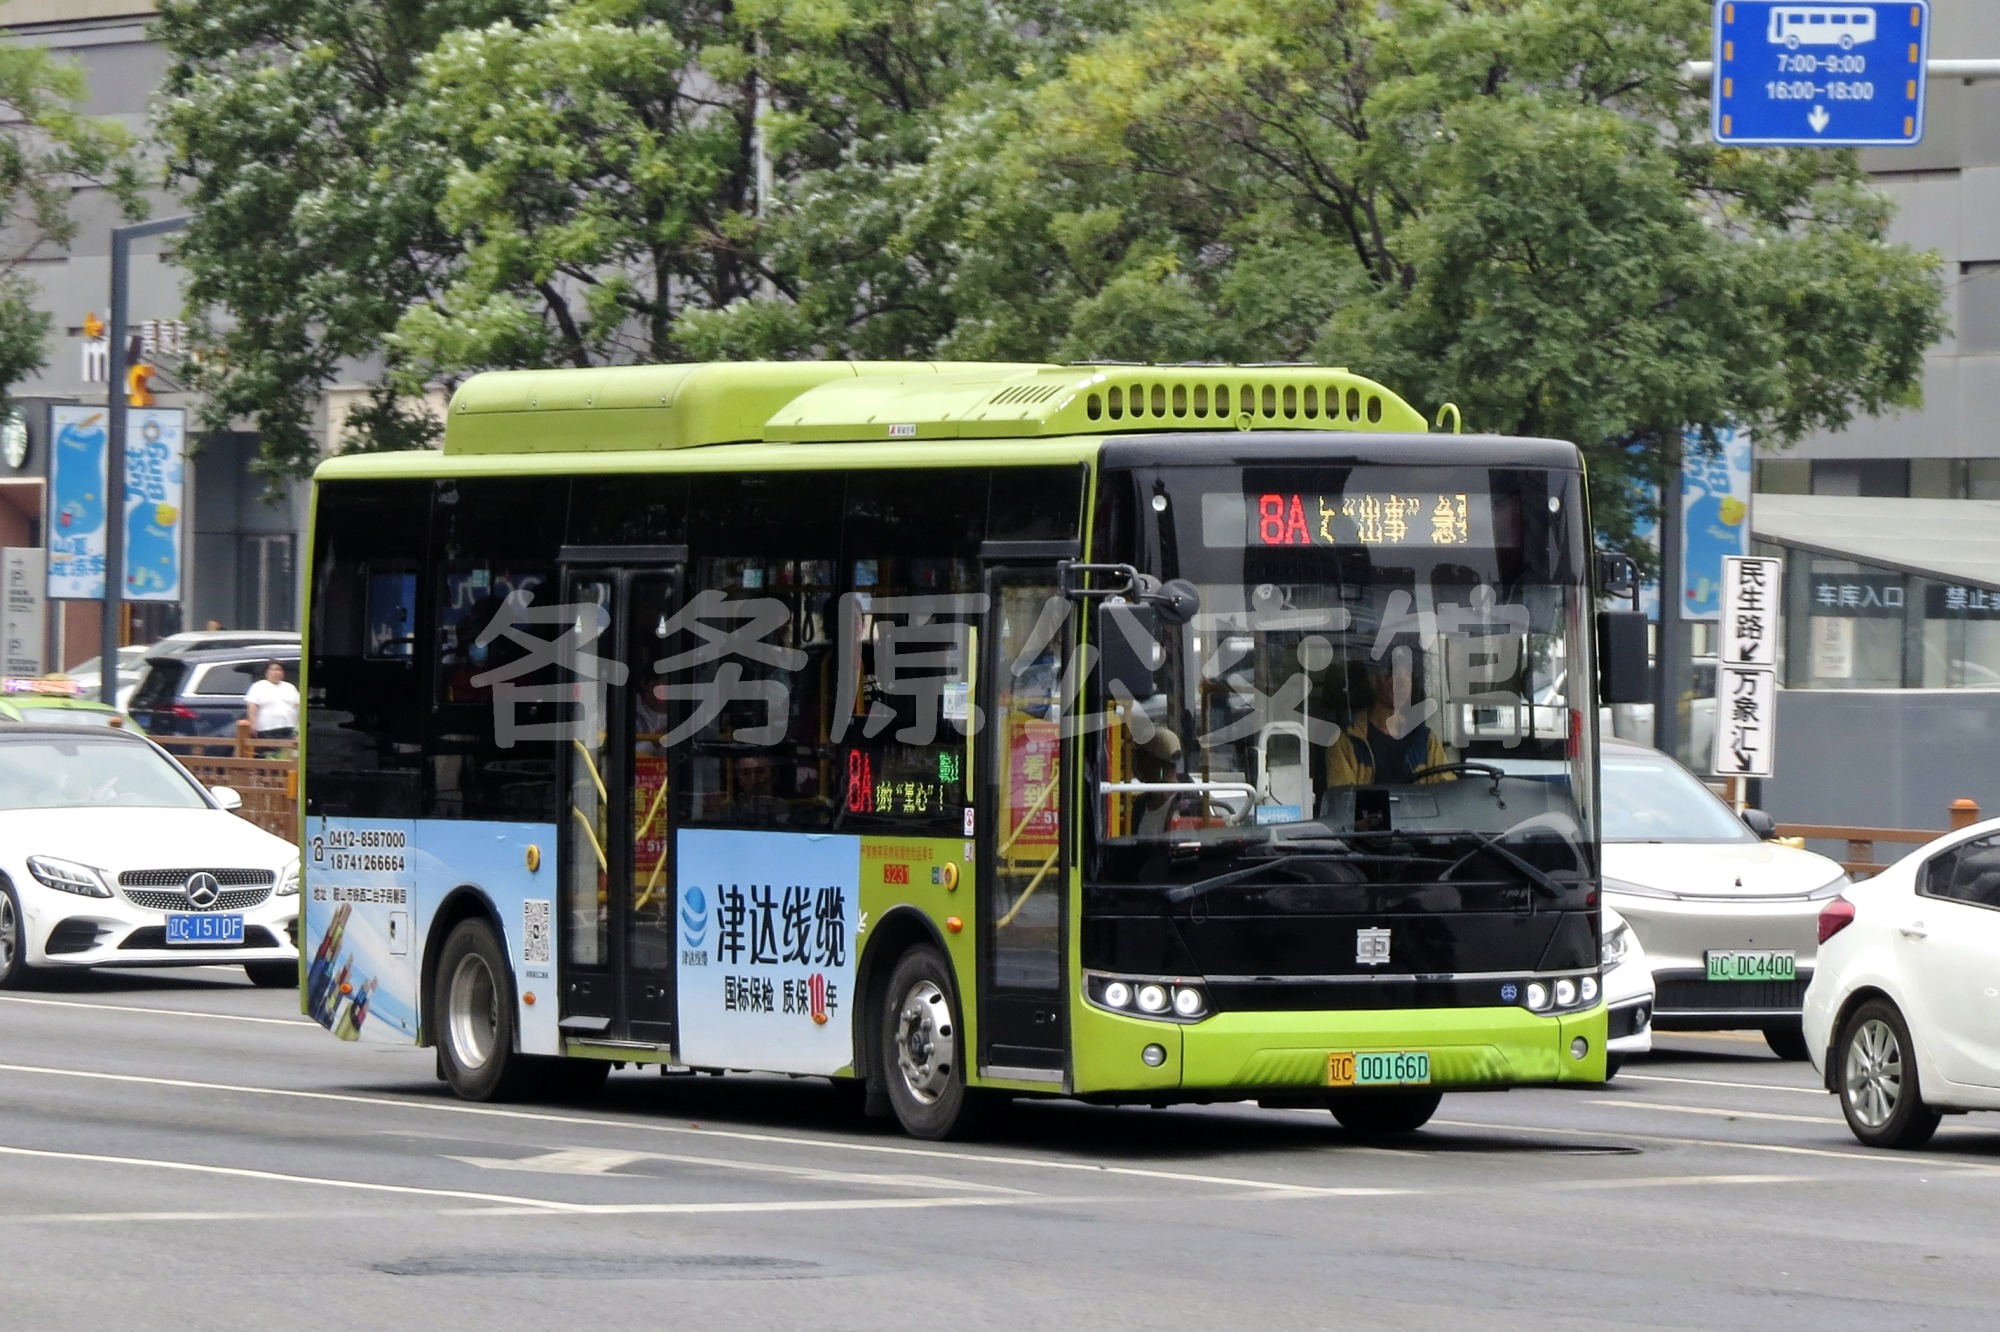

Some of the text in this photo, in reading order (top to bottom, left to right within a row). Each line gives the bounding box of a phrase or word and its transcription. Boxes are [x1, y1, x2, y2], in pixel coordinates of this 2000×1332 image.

[1777, 54, 1866, 74] 7:00-9:00
[1766, 81, 1874, 100] 16:00-18:00
[1258, 494, 1311, 544] 8A
[1736, 561, 1766, 640] 民生路
[1816, 583, 1904, 608] 车库入口
[1730, 668, 1760, 751] 万象汇
[849, 748, 873, 812] 8A
[329, 830, 406, 849] 0412-8587000
[330, 854, 405, 872] 18741266664
[885, 865, 910, 883] 3231
[717, 884, 846, 967] 津达线缆
[1737, 956, 1793, 976] DC4400
[725, 973, 838, 1018] 国标保检 质保10年
[1330, 1055, 1428, 1081] 辽C 00166D
